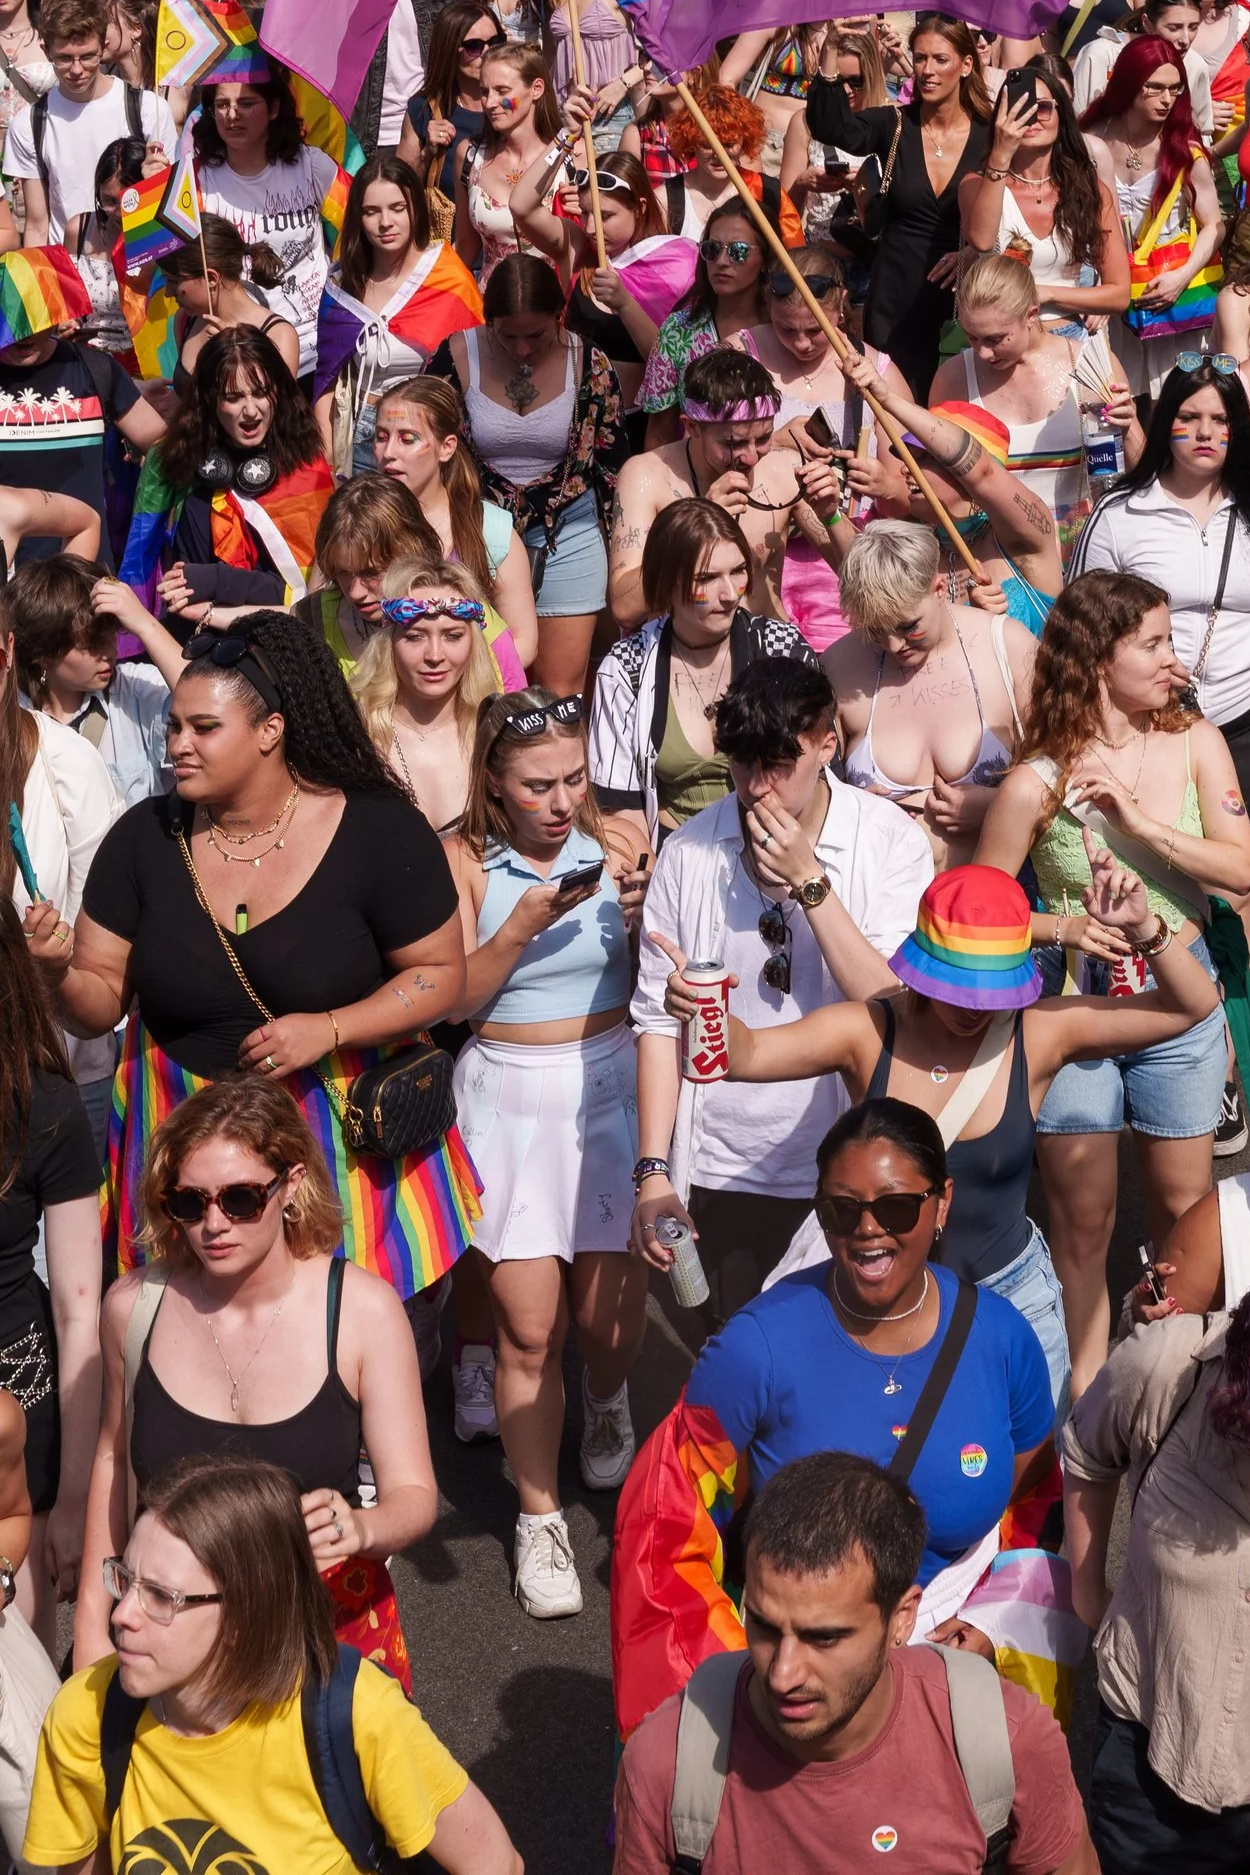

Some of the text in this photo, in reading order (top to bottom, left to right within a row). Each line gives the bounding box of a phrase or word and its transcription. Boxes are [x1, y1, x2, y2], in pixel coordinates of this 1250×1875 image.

[1179, 355, 1235, 369] KISS ME
[1087, 452, 1114, 465] Quelle
[518, 701, 577, 732] KISS ME
[691, 996, 729, 1076] Stiegl
